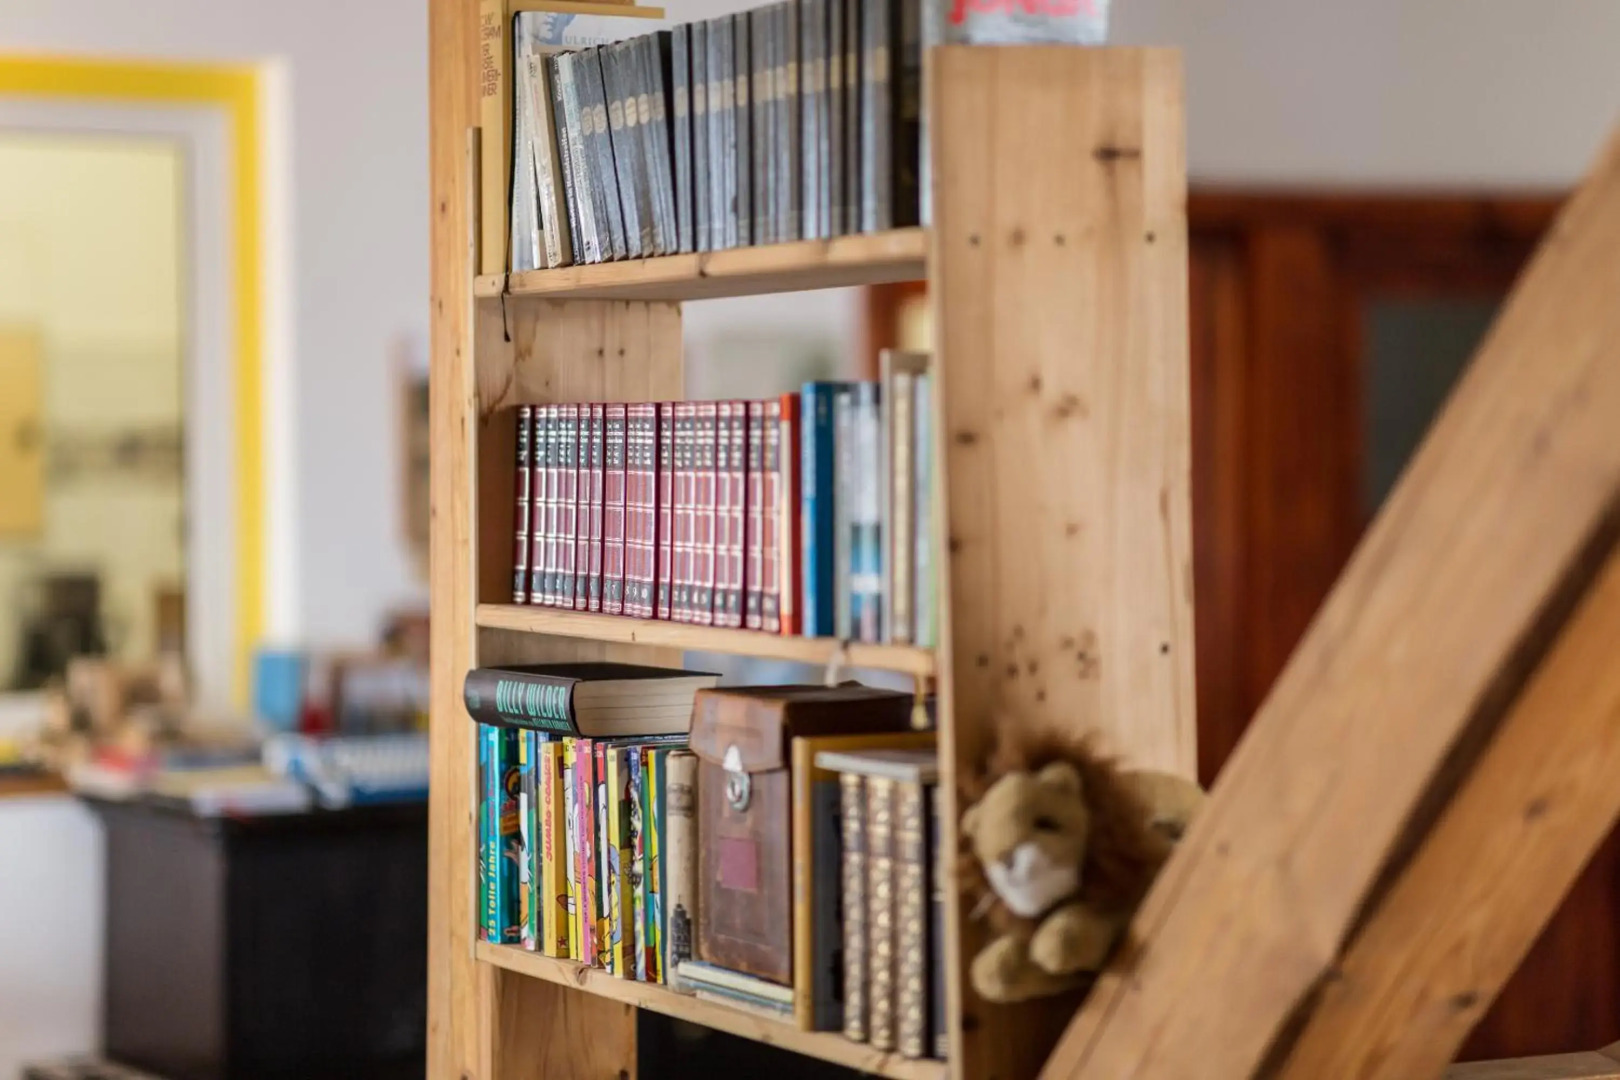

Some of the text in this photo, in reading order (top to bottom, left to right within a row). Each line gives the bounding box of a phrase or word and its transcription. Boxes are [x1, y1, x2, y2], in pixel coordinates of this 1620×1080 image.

[496, 680, 567, 719] BILLY WILDER
[488, 840, 496, 878] Jahre
[488, 881, 496, 915] Tolle
[488, 919, 497, 937] 25
